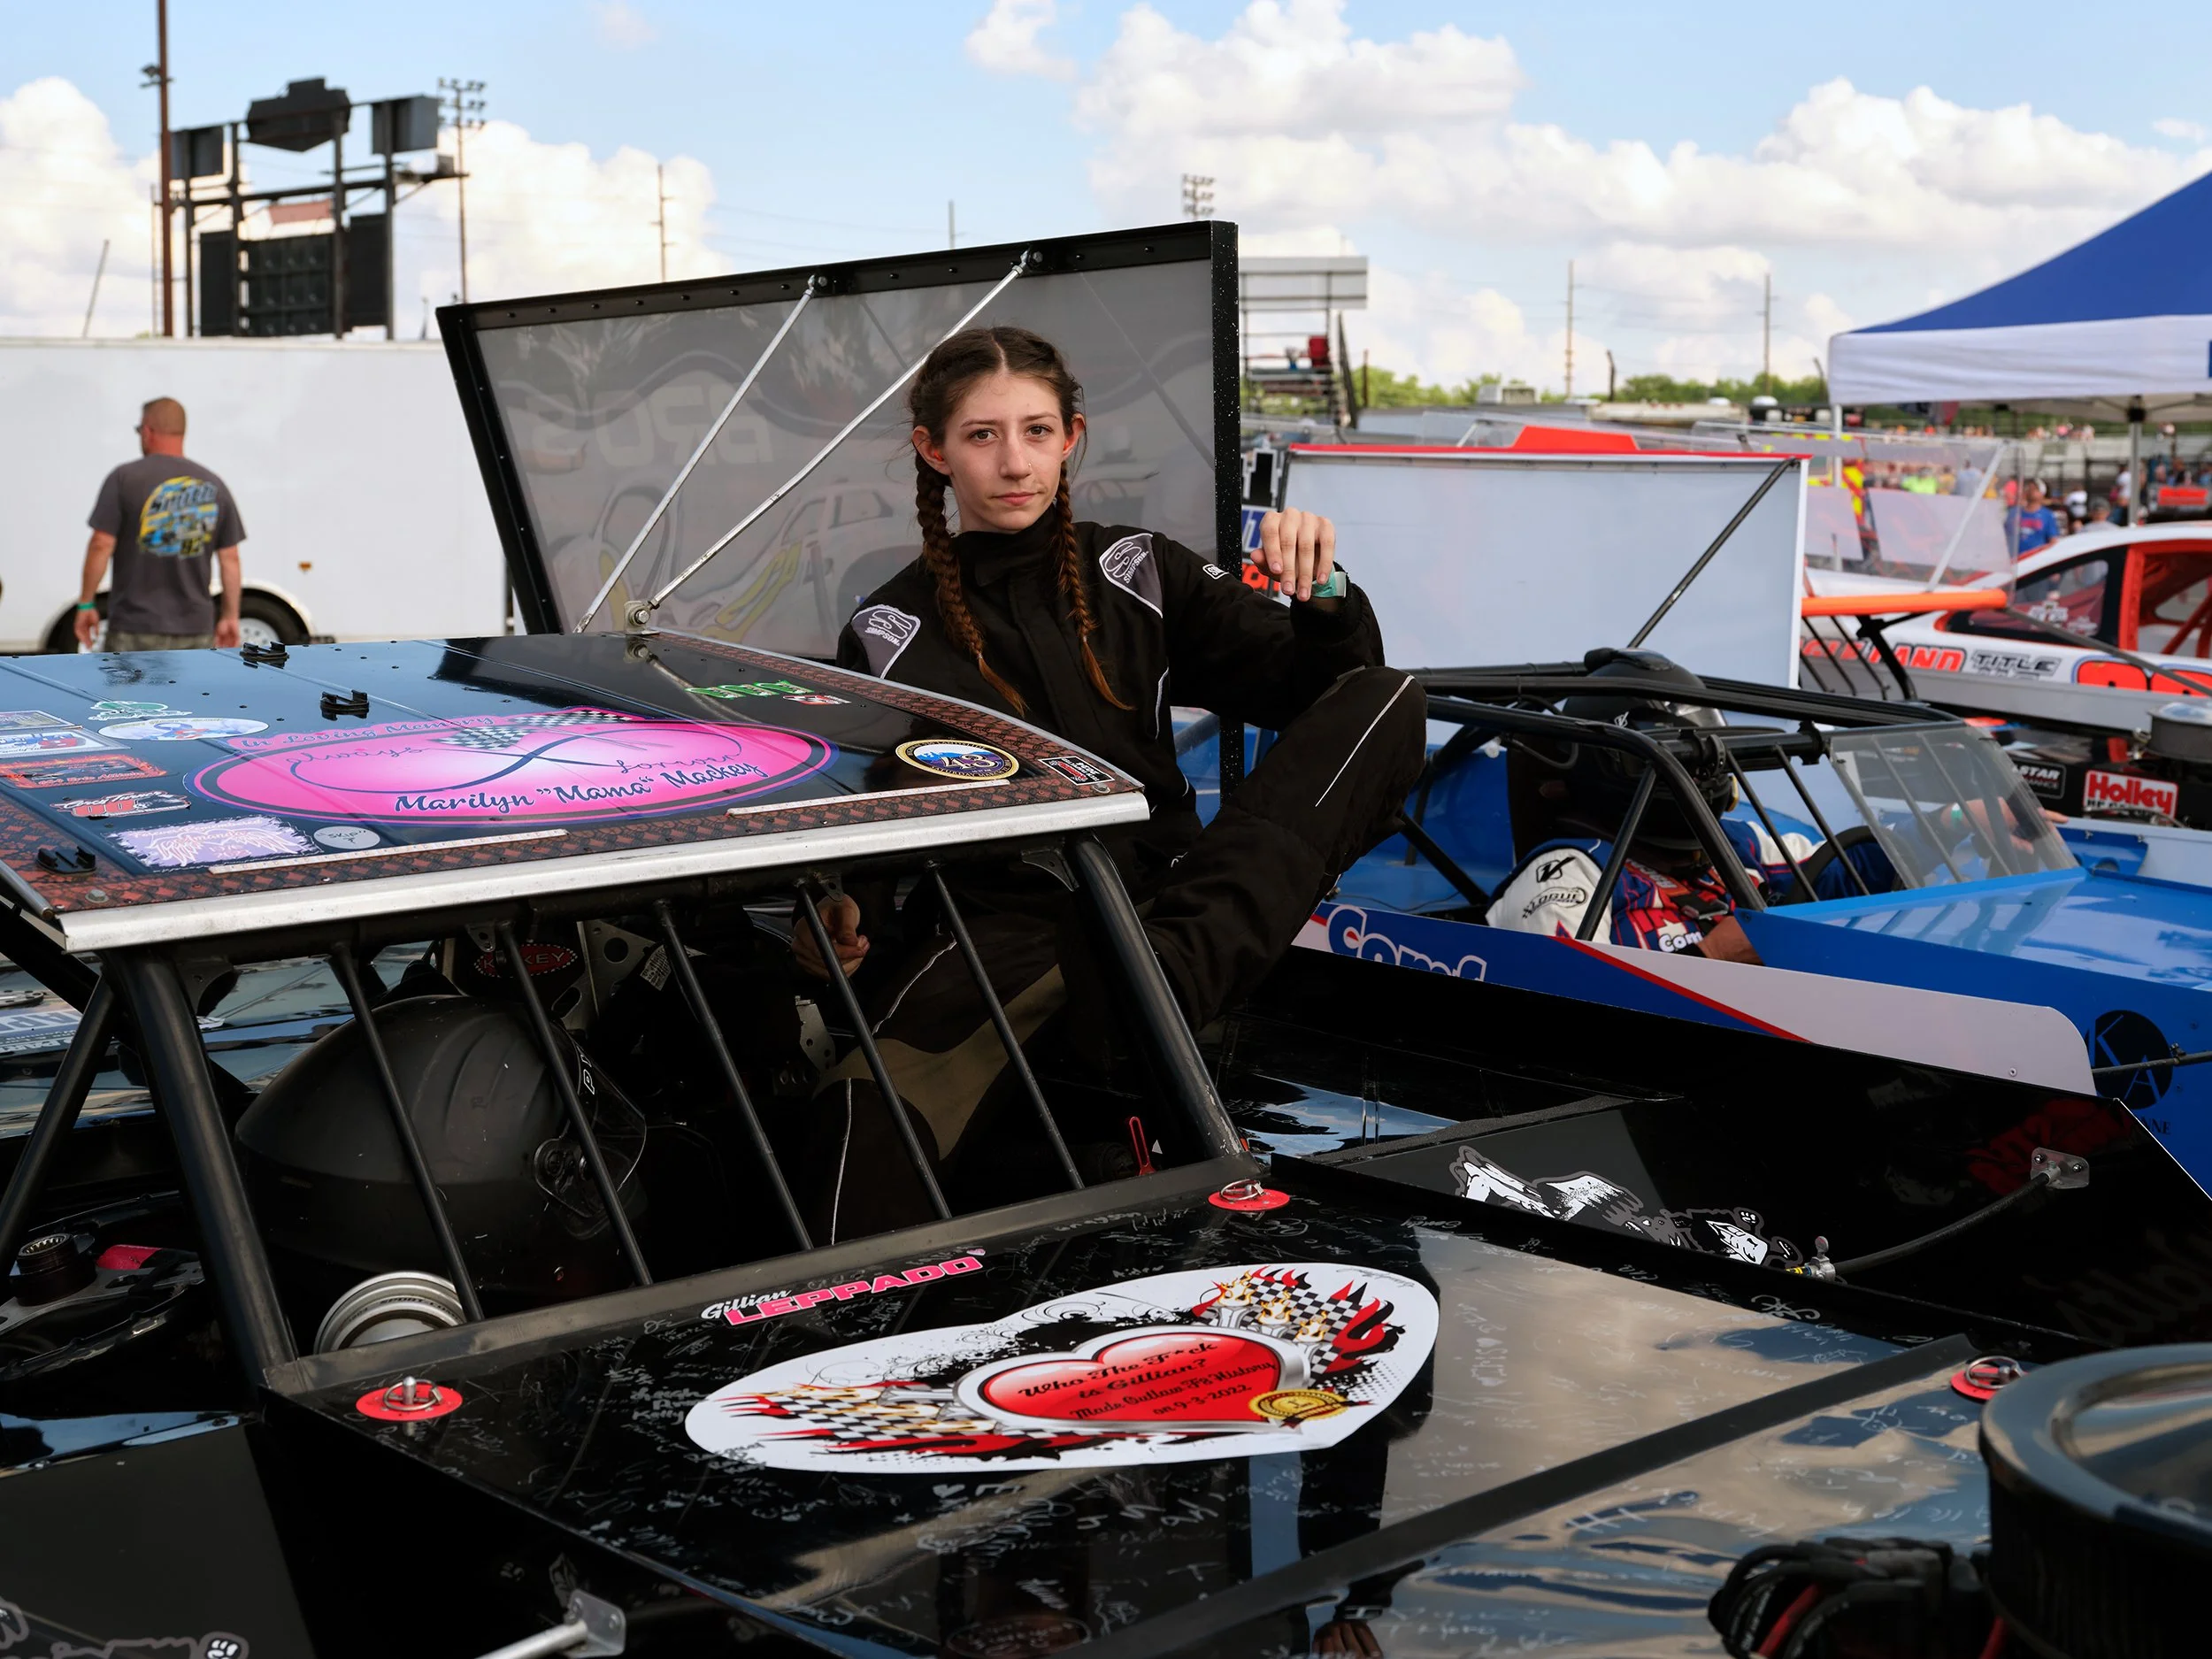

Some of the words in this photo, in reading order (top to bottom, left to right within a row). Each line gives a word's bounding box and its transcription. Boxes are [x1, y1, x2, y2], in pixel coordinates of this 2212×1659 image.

[1123, 550, 1148, 585] SIMPSON
[864, 626, 901, 647] SIMPSON
[1974, 652, 2058, 674] TITLE
[240, 737, 273, 749] In
[282, 726, 378, 744] Loving
[384, 715, 495, 734] Memory
[395, 794, 534, 814] Marilyn
[663, 761, 770, 789] Mackey
[2087, 773, 2175, 821] Holley
[483, 950, 565, 971] KKEY
[700, 1289, 793, 1321] Gillian
[723, 1256, 984, 1325] LEPPADO
[1018, 1376, 1086, 1398] Who
[1088, 1361, 1143, 1380] The
[1068, 1402, 1124, 1420] Made
[1124, 1386, 1184, 1408] Outlaw
[1210, 1361, 1279, 1386] History
[1079, 1388, 1104, 1400] is
[1106, 1358, 1208, 1392] Gillian?
[1152, 1405, 1176, 1416] on
[1174, 1384, 1253, 1411] 9-3-2022
